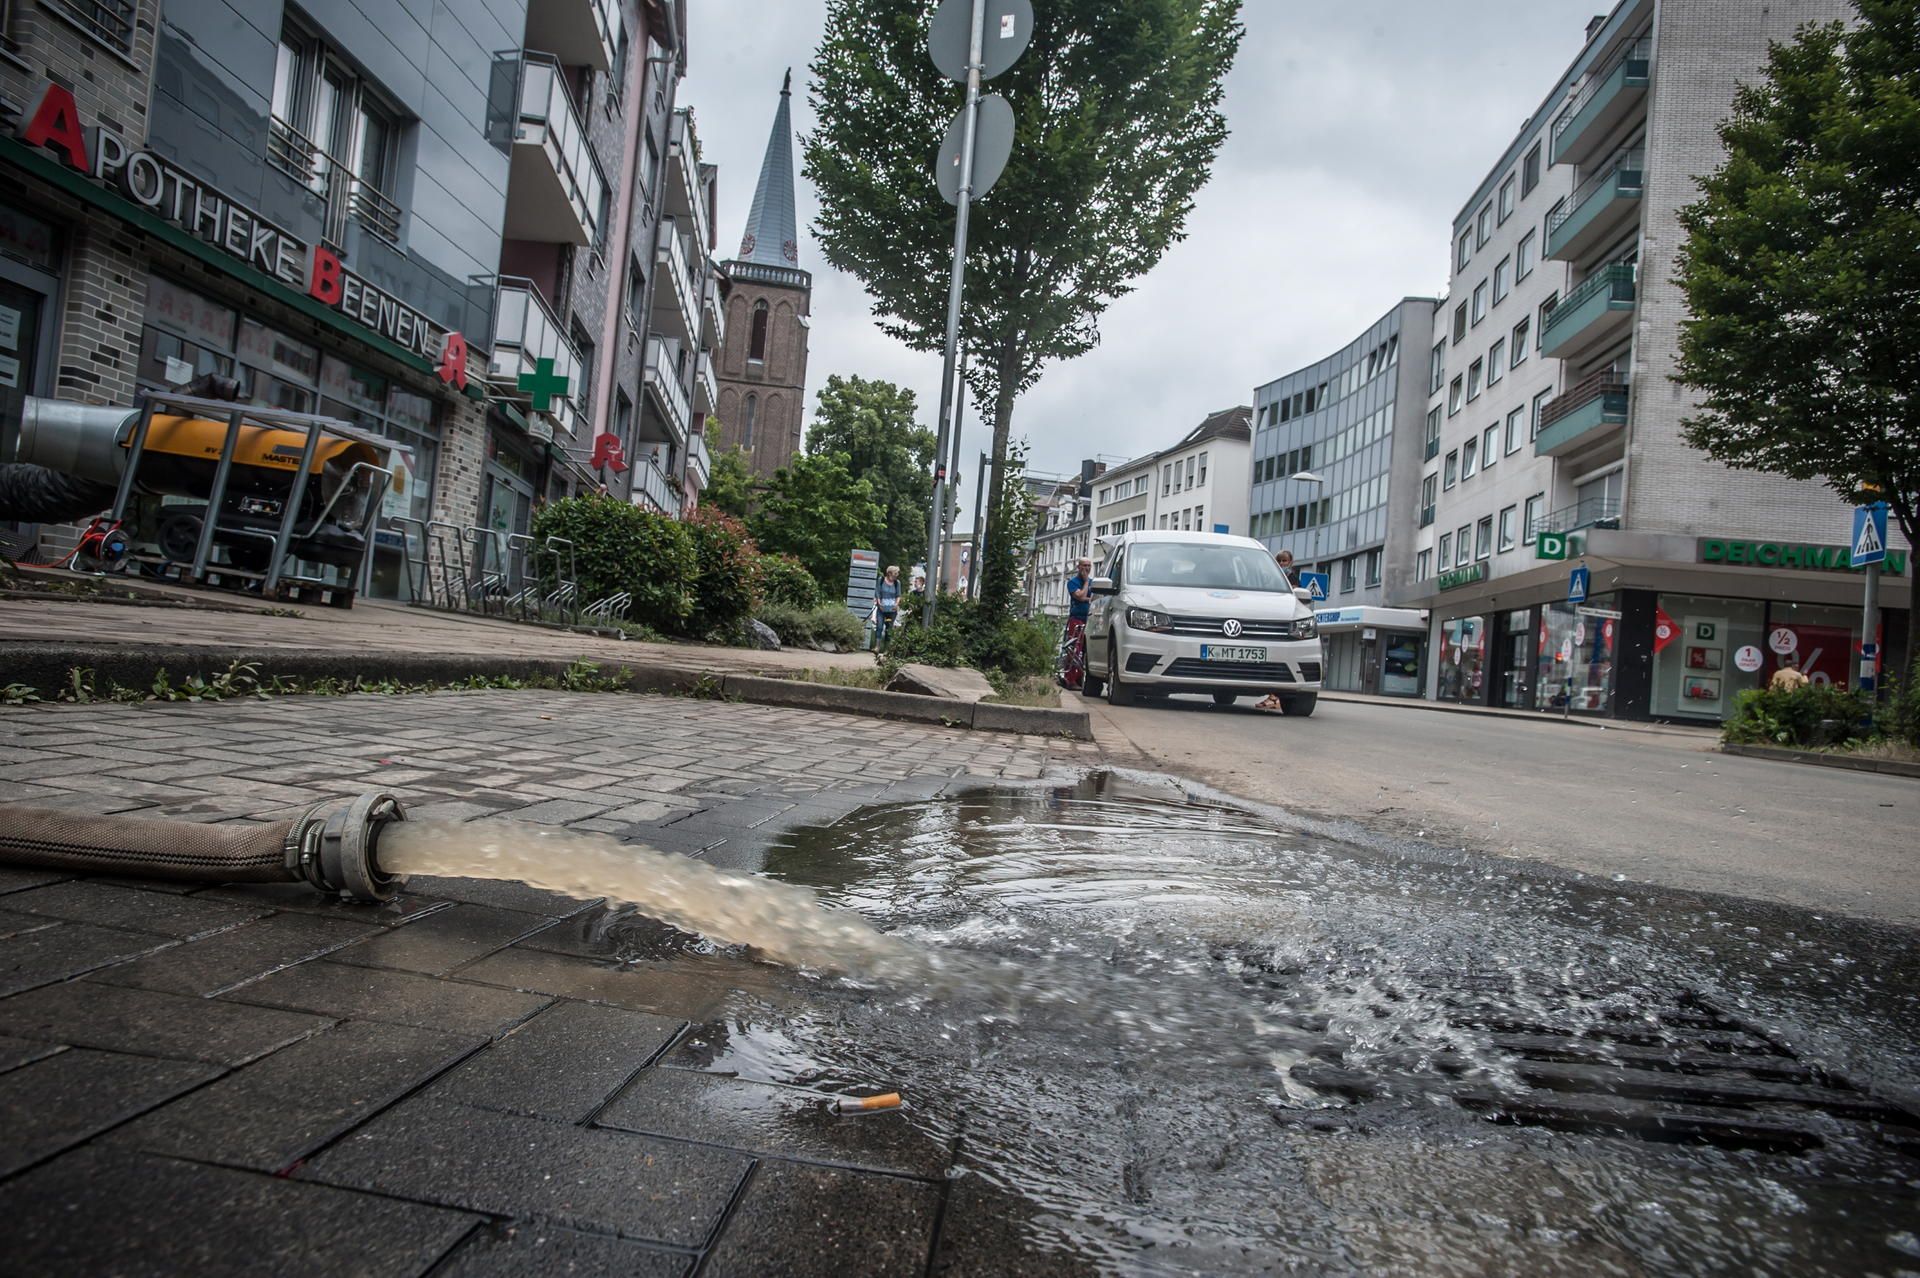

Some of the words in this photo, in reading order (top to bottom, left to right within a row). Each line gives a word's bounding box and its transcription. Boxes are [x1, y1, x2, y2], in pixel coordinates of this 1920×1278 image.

[24, 82, 298, 284] APOTHEKE
[308, 245, 429, 356] BEENEN
[263, 454, 301, 465] MASTE
[1544, 538, 1561, 555] D
[1704, 540, 1906, 573] DEICHMAN
[1208, 647, 1215, 658] K
[1222, 647, 1236, 658] MT
[1238, 648, 1265, 660] 1753
[1745, 647, 1752, 657] 1
